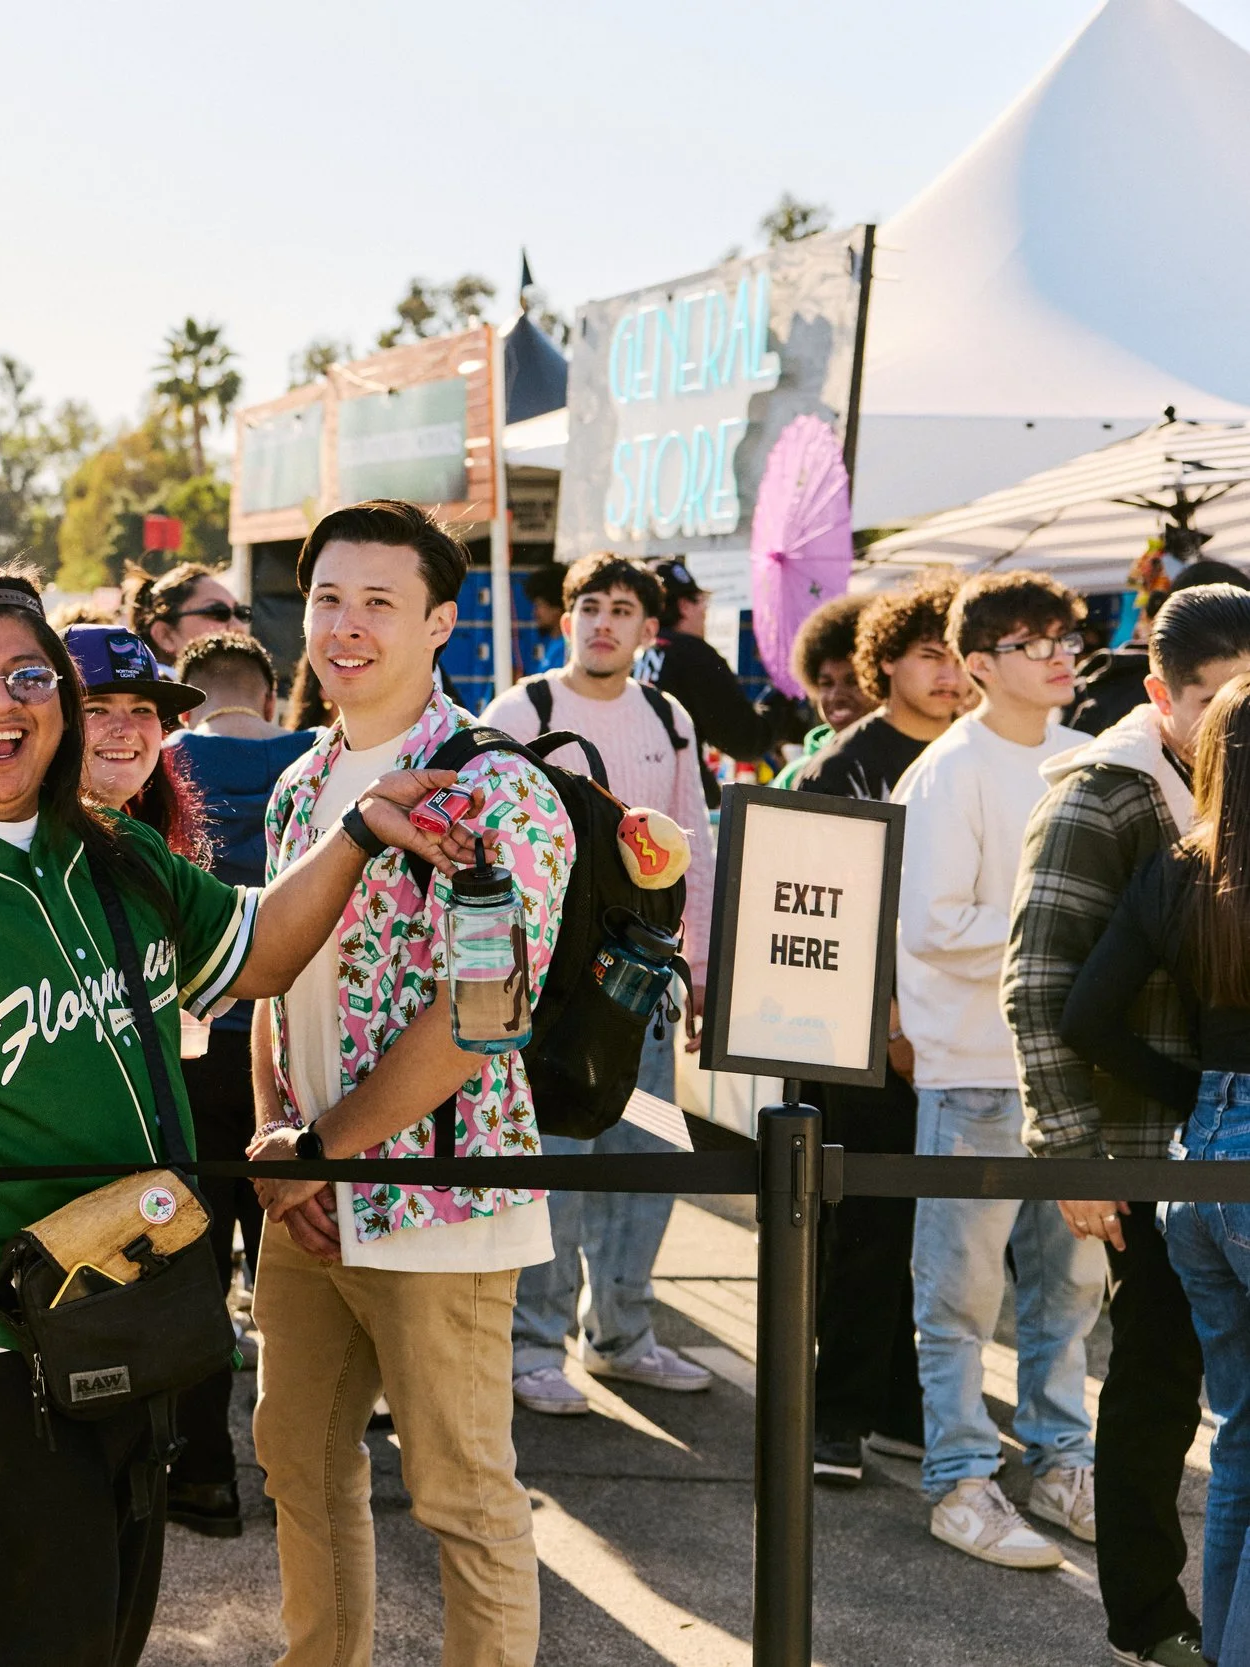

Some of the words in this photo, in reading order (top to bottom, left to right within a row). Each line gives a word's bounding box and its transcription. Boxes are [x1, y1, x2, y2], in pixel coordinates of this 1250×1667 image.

[607, 270, 781, 404] GENERAL
[606, 416, 750, 531] STORE
[774, 881, 843, 919] EXIT
[770, 933, 840, 971] HERE
[76, 1373, 125, 1392] RAW
